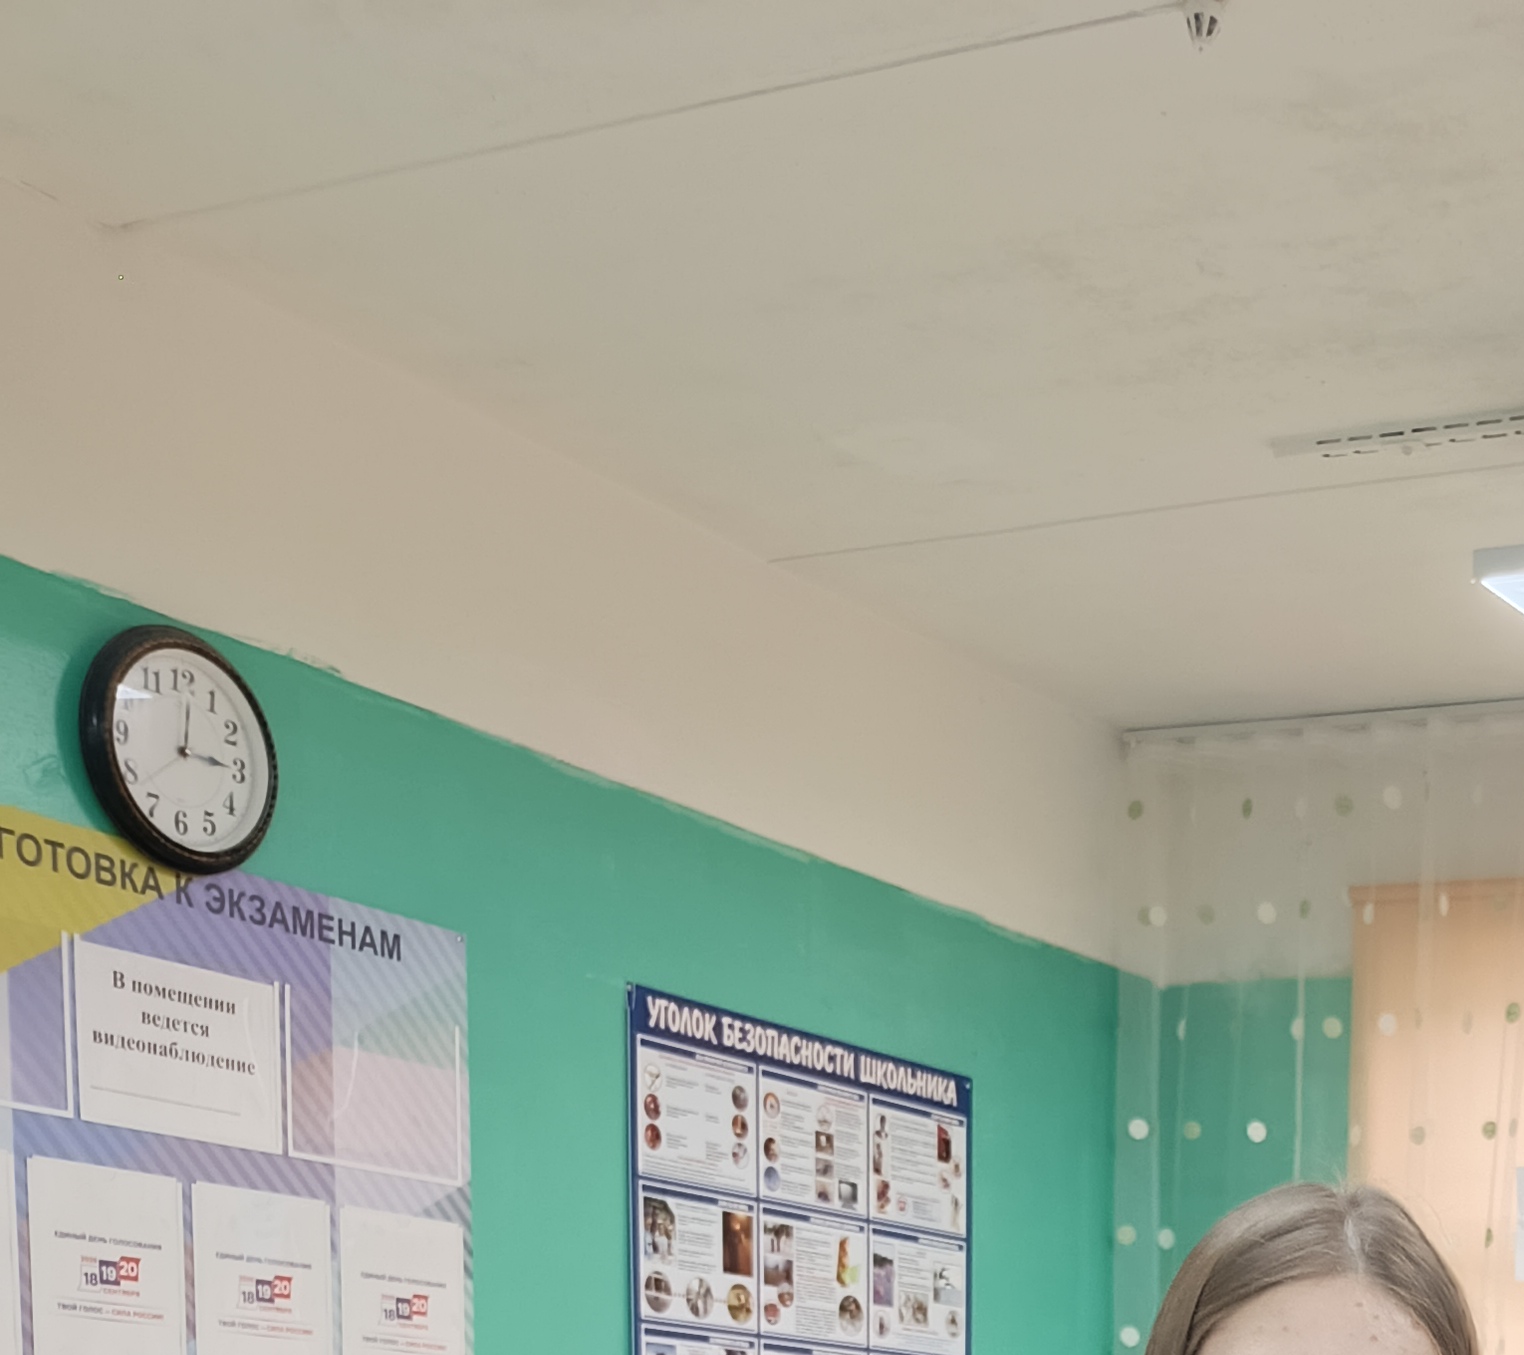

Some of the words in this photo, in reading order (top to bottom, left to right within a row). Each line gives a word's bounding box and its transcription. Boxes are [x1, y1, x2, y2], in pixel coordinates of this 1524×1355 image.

[142, 667, 162, 695] 11
[171, 668, 195, 696] 12
[206, 689, 218, 715] 1
[116, 719, 128, 745] 9
[224, 720, 237, 746] 2
[124, 759, 138, 784] 8
[232, 758, 245, 784] 3
[147, 792, 159, 818] 7
[223, 791, 236, 817] 4
[174, 810, 188, 835] 6
[203, 810, 216, 836] 5
[175, 873, 194, 908] К
[205, 883, 401, 961] ЭКЗАМЕНАМ
[113, 970, 125, 989] В
[131, 980, 236, 1015] помещении
[141, 1011, 209, 1038] ведется
[93, 1030, 256, 1076] видеонаблюдение
[647, 996, 718, 1045] УГОЛОК
[721, 1016, 855, 1080] БЕЗОПАСНОСТИ
[859, 1055, 958, 1107] ШКОЛЬНИКА
[83, 1271, 98, 1286] 18
[101, 1265, 117, 1281] 19
[119, 1261, 138, 1277] 20
[241, 1290, 254, 1304] 18
[258, 1284, 271, 1299] 19
[273, 1280, 290, 1295] 20
[383, 1308, 396, 1321] 18
[397, 1301, 410, 1317] 19
[411, 1297, 427, 1312] 20
